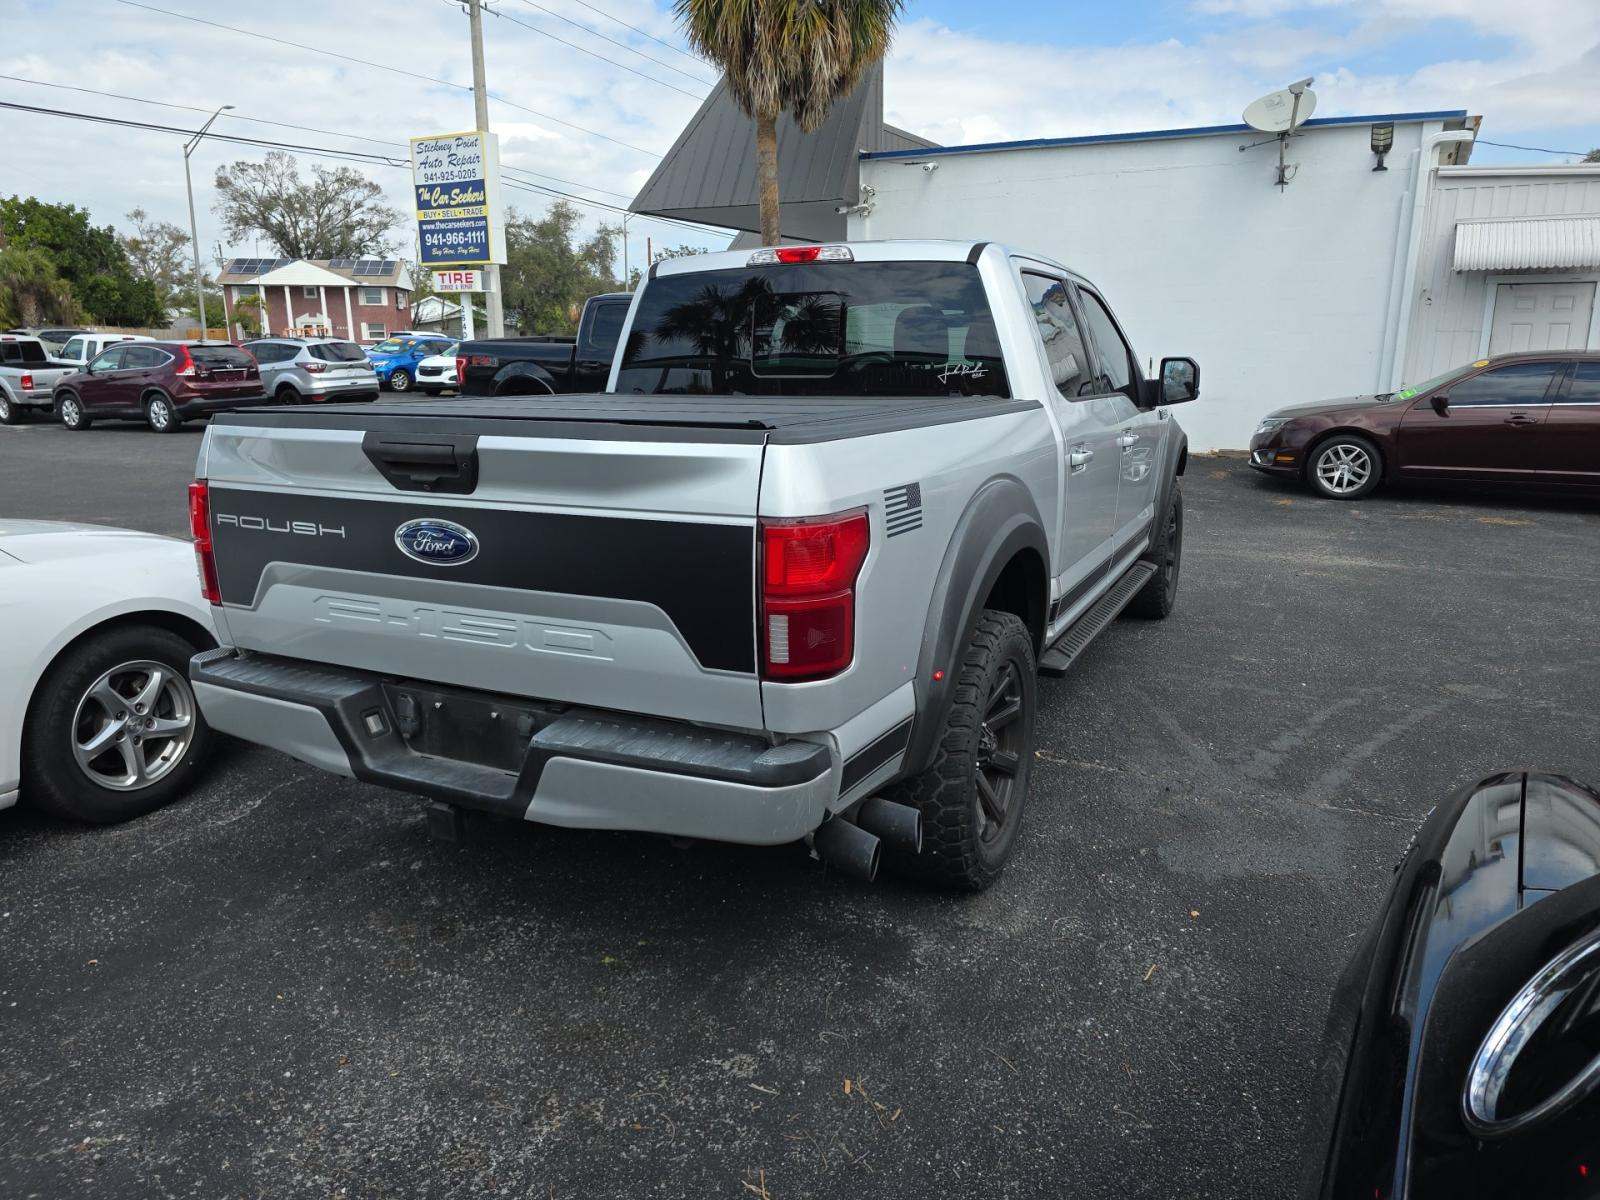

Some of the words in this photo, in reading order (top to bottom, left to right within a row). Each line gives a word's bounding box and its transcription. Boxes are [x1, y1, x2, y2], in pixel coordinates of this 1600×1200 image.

[416, 141, 452, 154] Stickney
[455, 137, 479, 149] Point
[418, 156, 443, 169] Auto
[447, 153, 480, 168] Repair
[424, 169, 476, 182] 941-925-0205
[418, 187, 430, 201] The
[431, 187, 449, 206] Car
[450, 187, 484, 206] Seekers
[424, 210, 436, 218] BUY
[441, 209, 458, 218] SELL
[463, 207, 483, 216] TRADE
[422, 220, 486, 230] www.thecarseekers.com
[425, 231, 485, 245] 941-966-1111
[432, 248, 442, 256] Buy
[458, 247, 468, 255] Pay
[438, 272, 473, 284] TIRE
[217, 514, 345, 538] ROUSH
[414, 530, 455, 553] Ford
[313, 596, 614, 661] F-150
